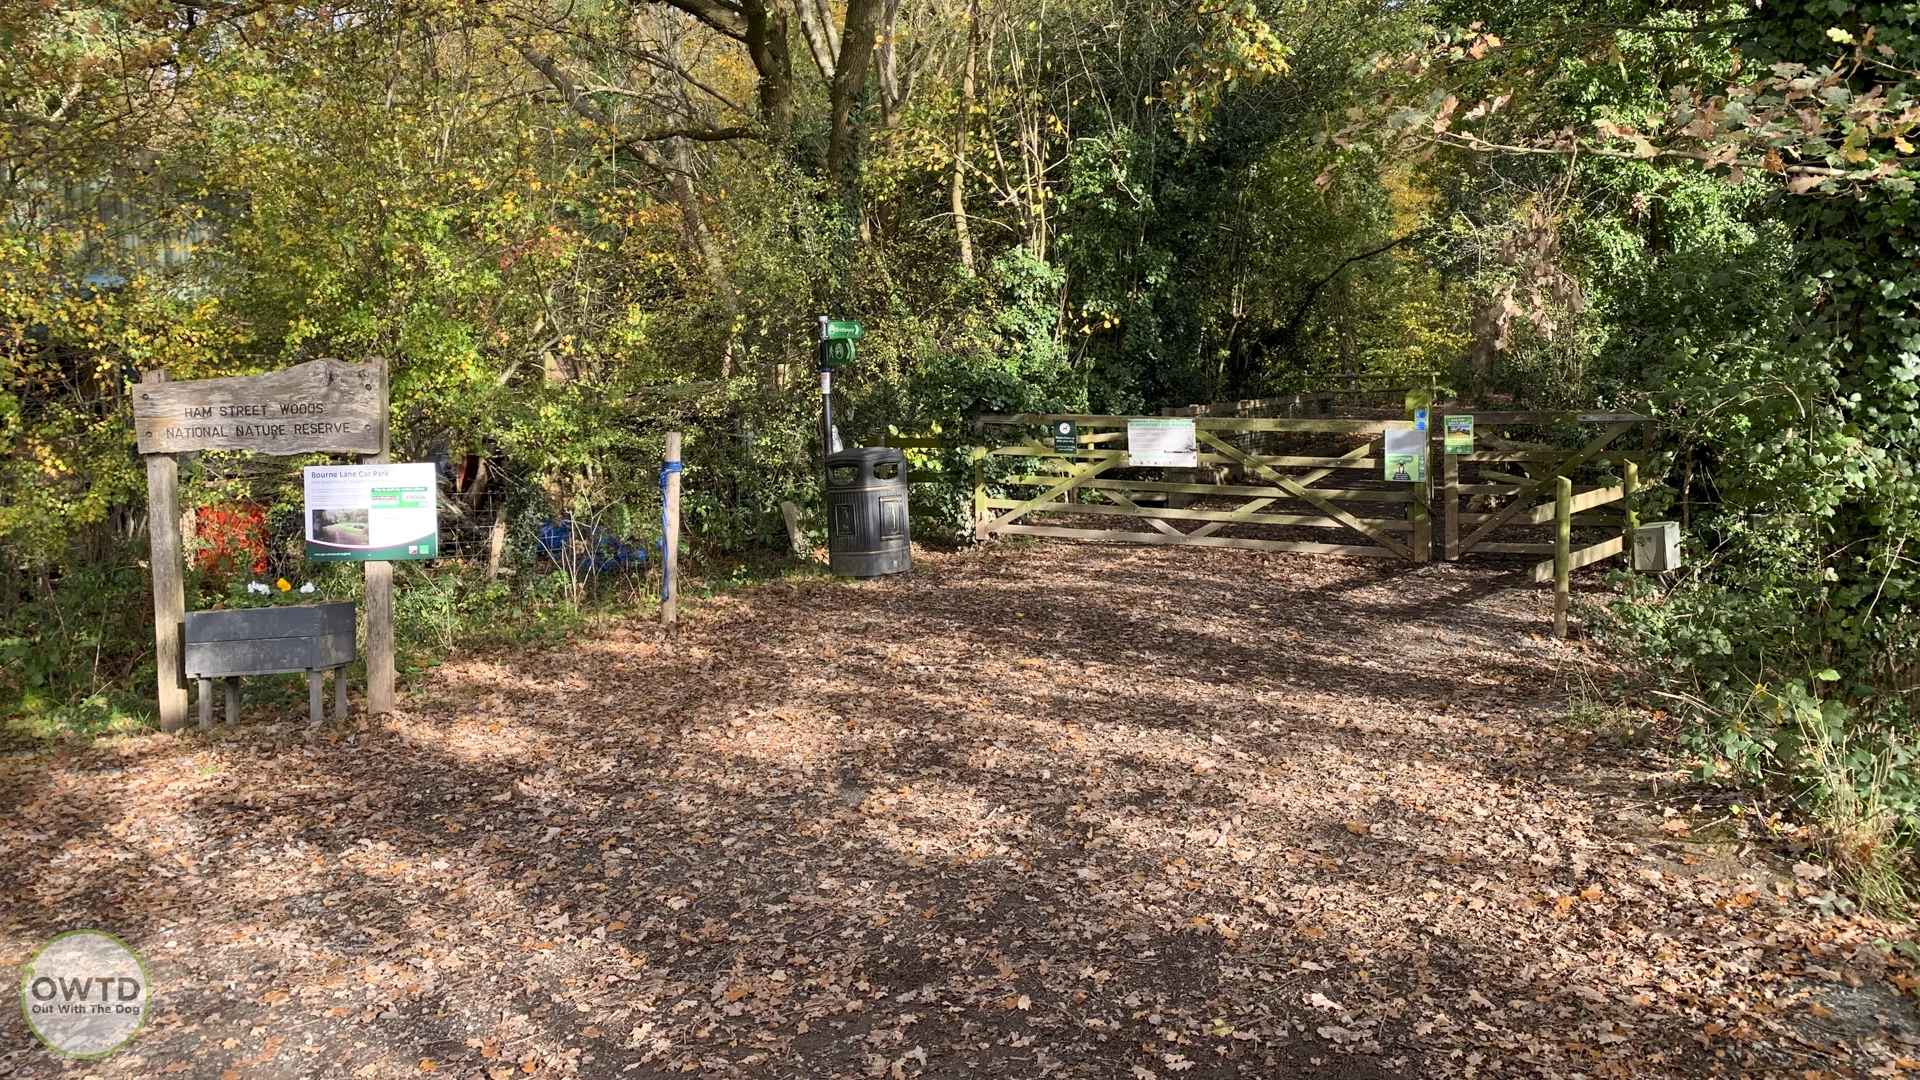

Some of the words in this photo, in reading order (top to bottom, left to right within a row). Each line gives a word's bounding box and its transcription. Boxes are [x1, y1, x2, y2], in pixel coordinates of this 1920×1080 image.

[184, 406, 212, 417] HAM
[220, 405, 267, 416] STREET
[280, 403, 324, 415] WOODS
[166, 426, 228, 439] NATIONAL
[236, 424, 286, 437] NATURE
[294, 422, 351, 435] RESERVE
[311, 471, 338, 479] Bourne
